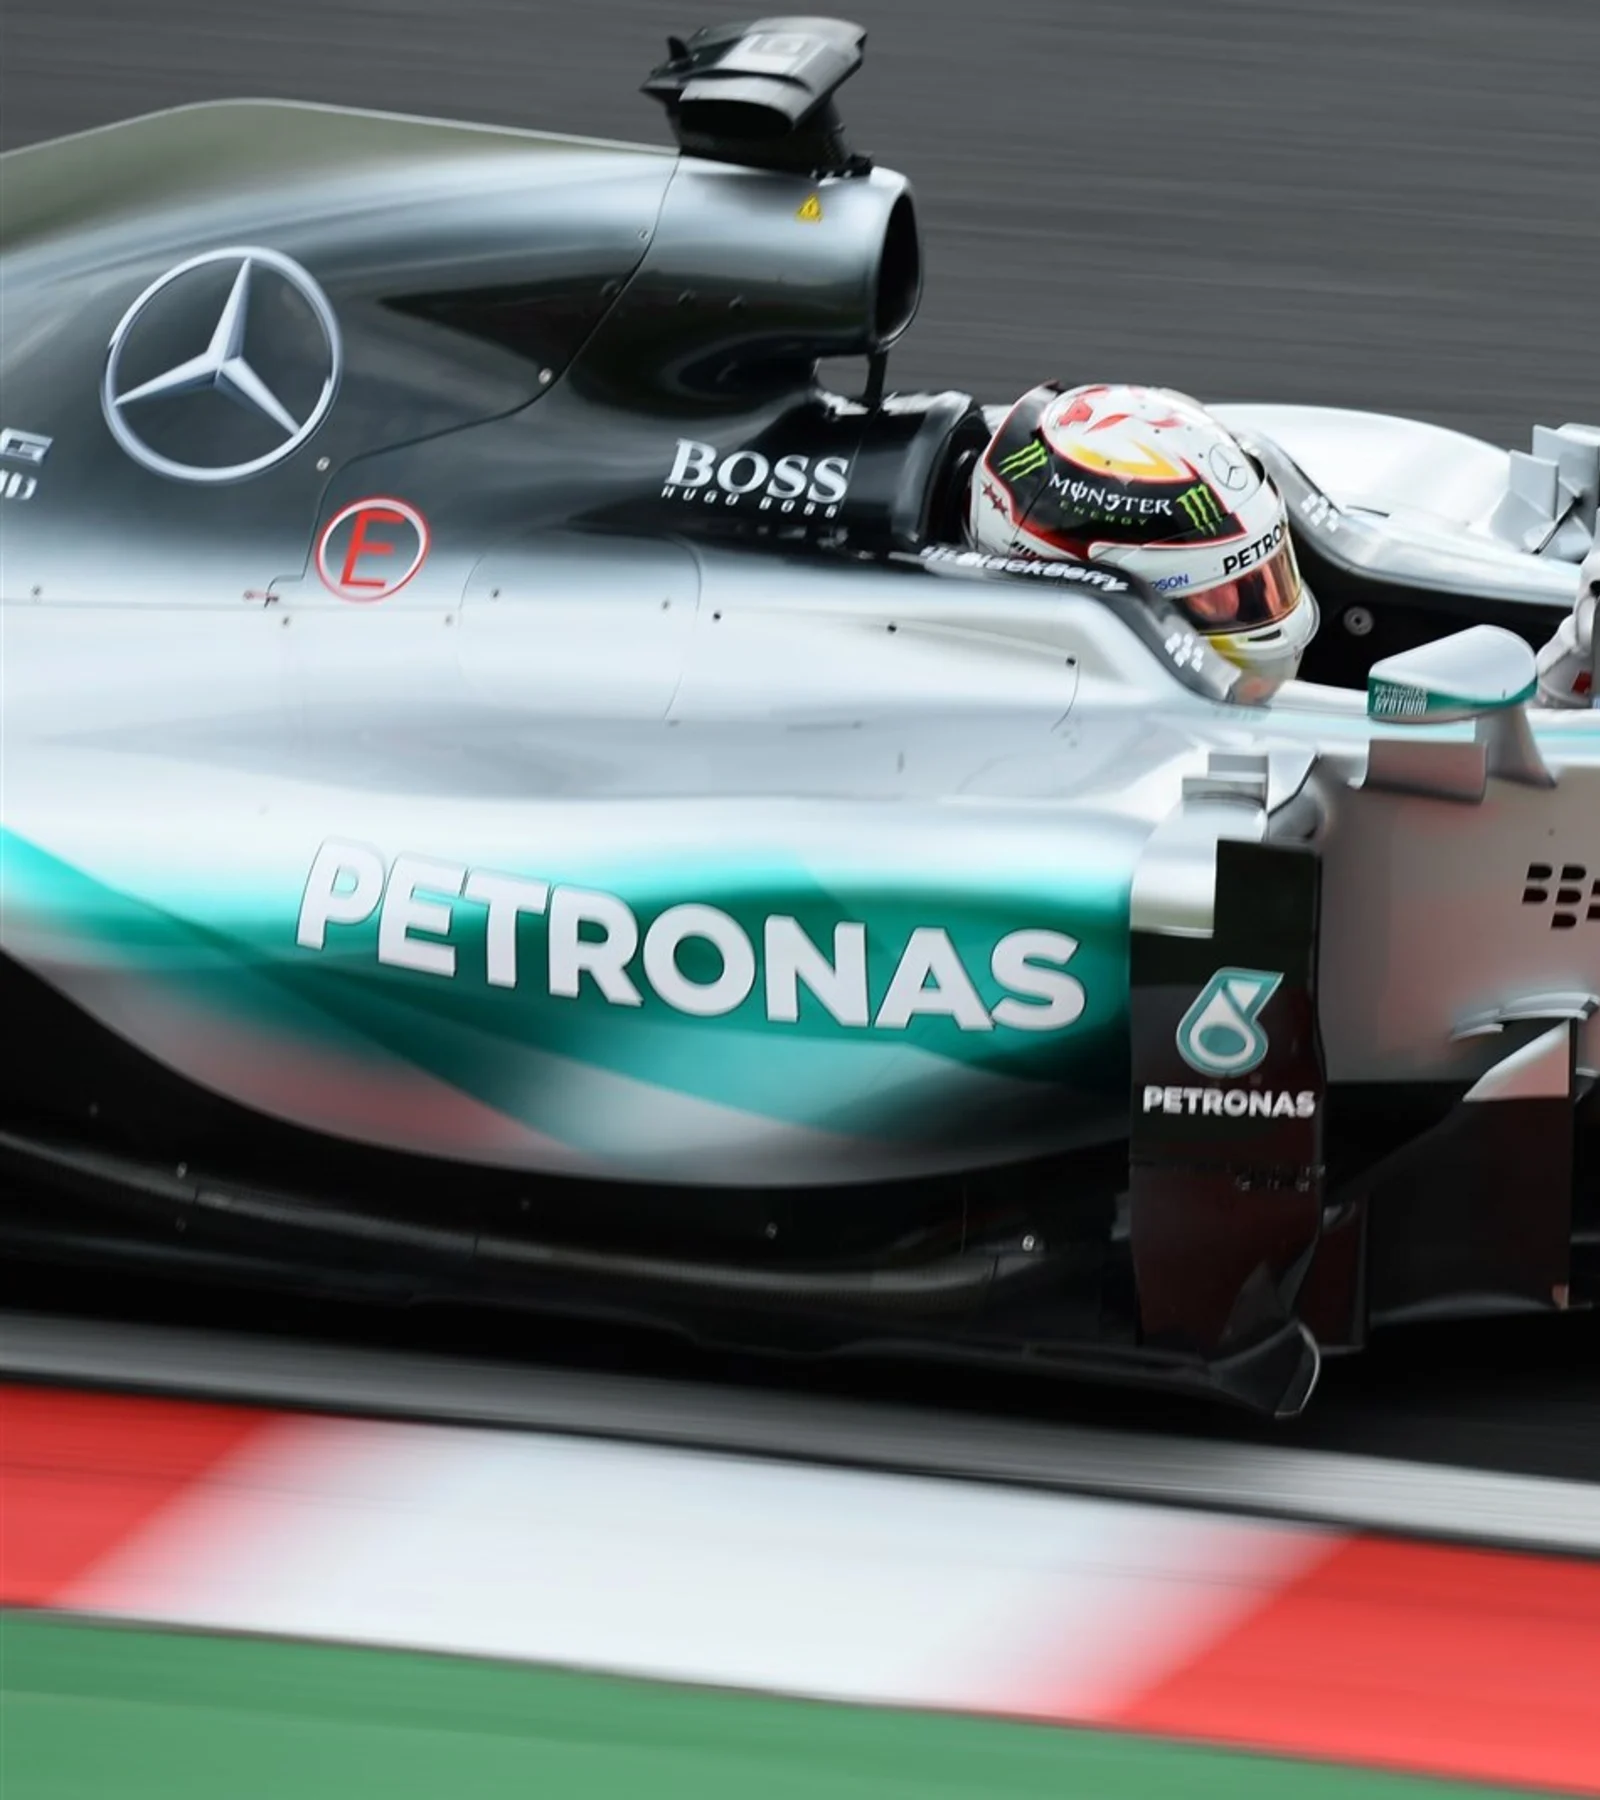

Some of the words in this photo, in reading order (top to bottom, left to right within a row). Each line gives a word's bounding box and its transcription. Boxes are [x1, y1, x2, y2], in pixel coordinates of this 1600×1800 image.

[664, 437, 850, 503] BOSS
[660, 485, 740, 506] HUGO
[759, 496, 838, 519] BOSS
[1048, 472, 1173, 516] MONSTER
[1060, 500, 1148, 526] ENERGY
[340, 510, 406, 590] E
[295, 835, 1086, 1031] PETRONAS
[1143, 1085, 1316, 1118] PETRONAS
